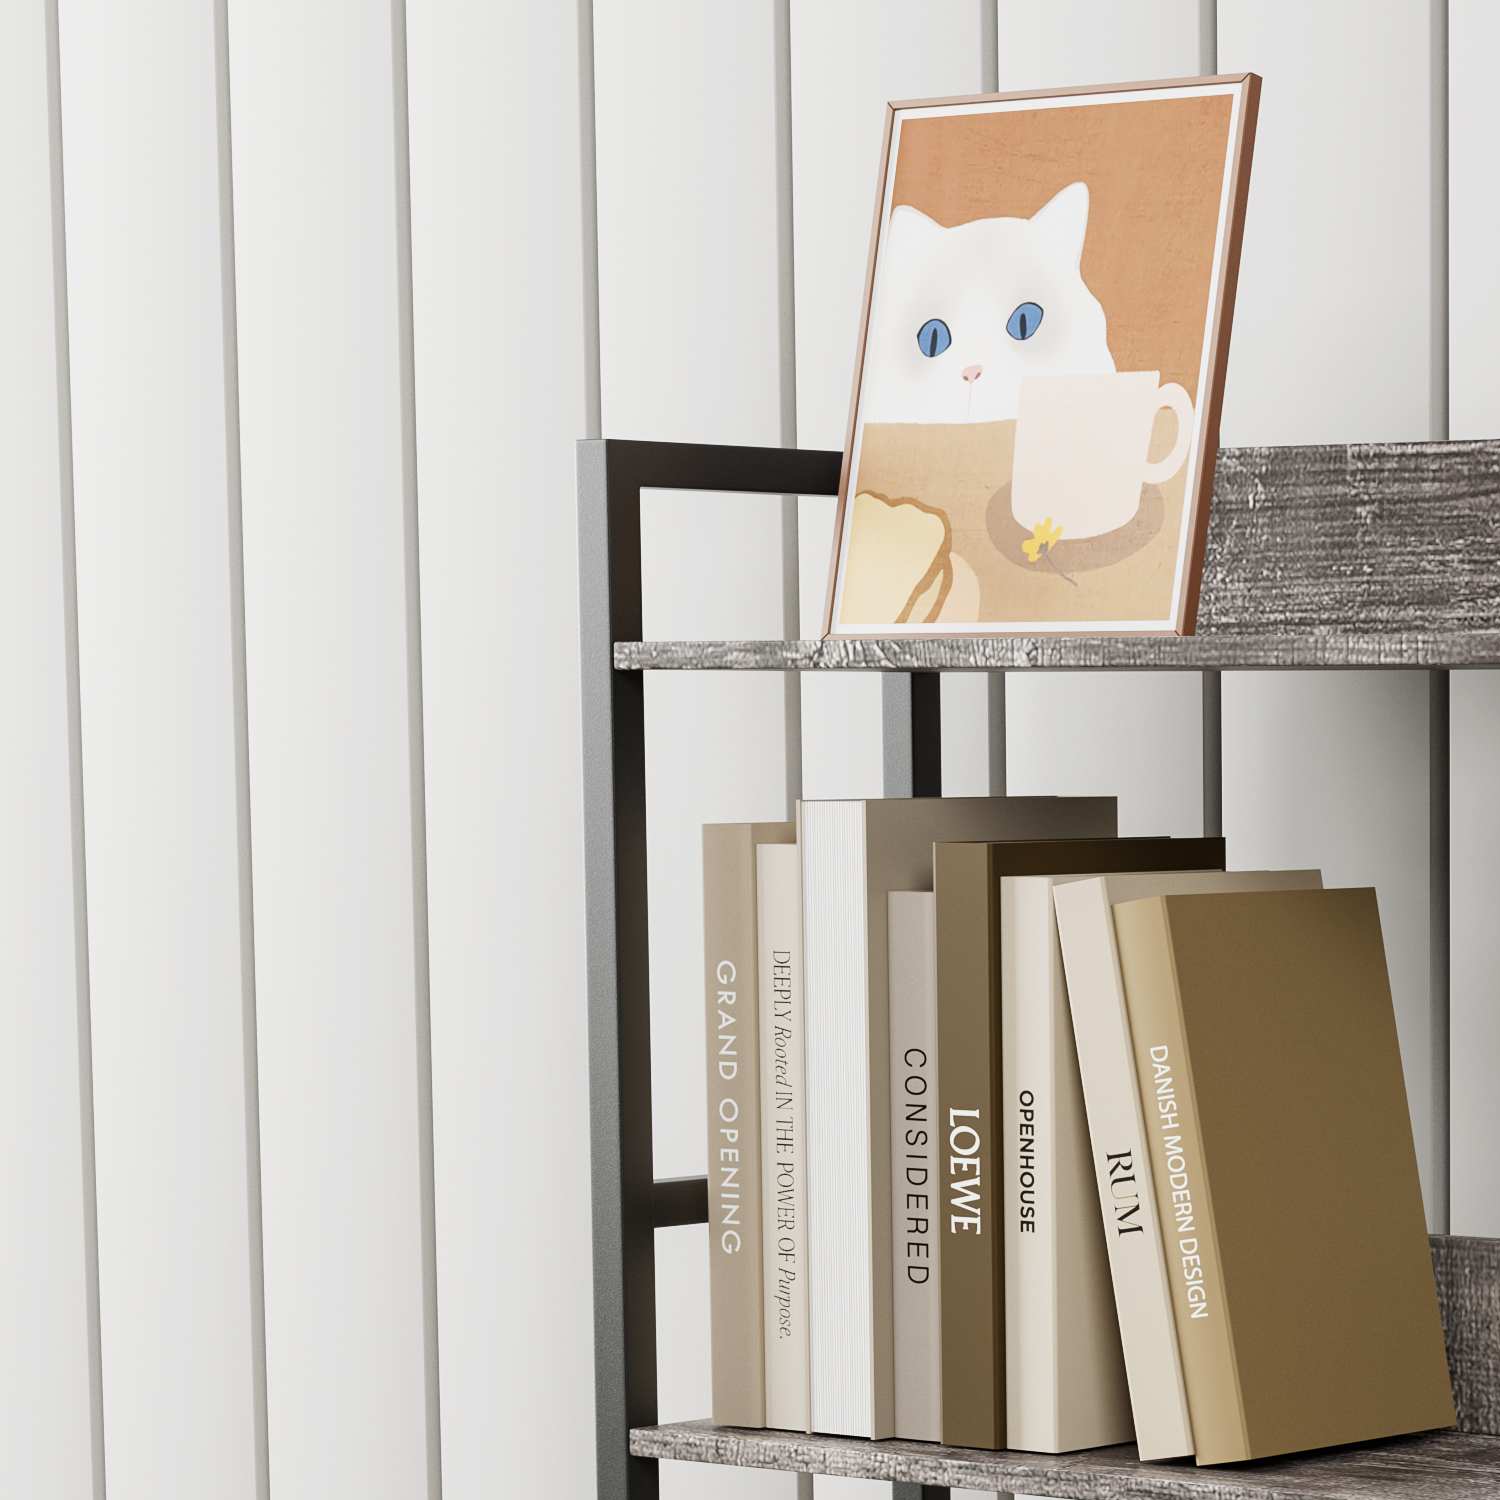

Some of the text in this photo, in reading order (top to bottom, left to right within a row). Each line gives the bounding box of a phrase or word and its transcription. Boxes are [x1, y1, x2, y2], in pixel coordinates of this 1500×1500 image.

[716, 960, 741, 1255] GRAND OPENING
[773, 950, 796, 1340] DEEPLY Rooted IN THE POWER OF Purpose.
[904, 1048, 930, 1284] CONSIDERED
[949, 1107, 981, 1235] LOEWE
[1019, 1089, 1035, 1234] OPENHOUSE
[1105, 1148, 1144, 1238] RUM
[1150, 1045, 1209, 1319] DANISH MODERN DESIGN
